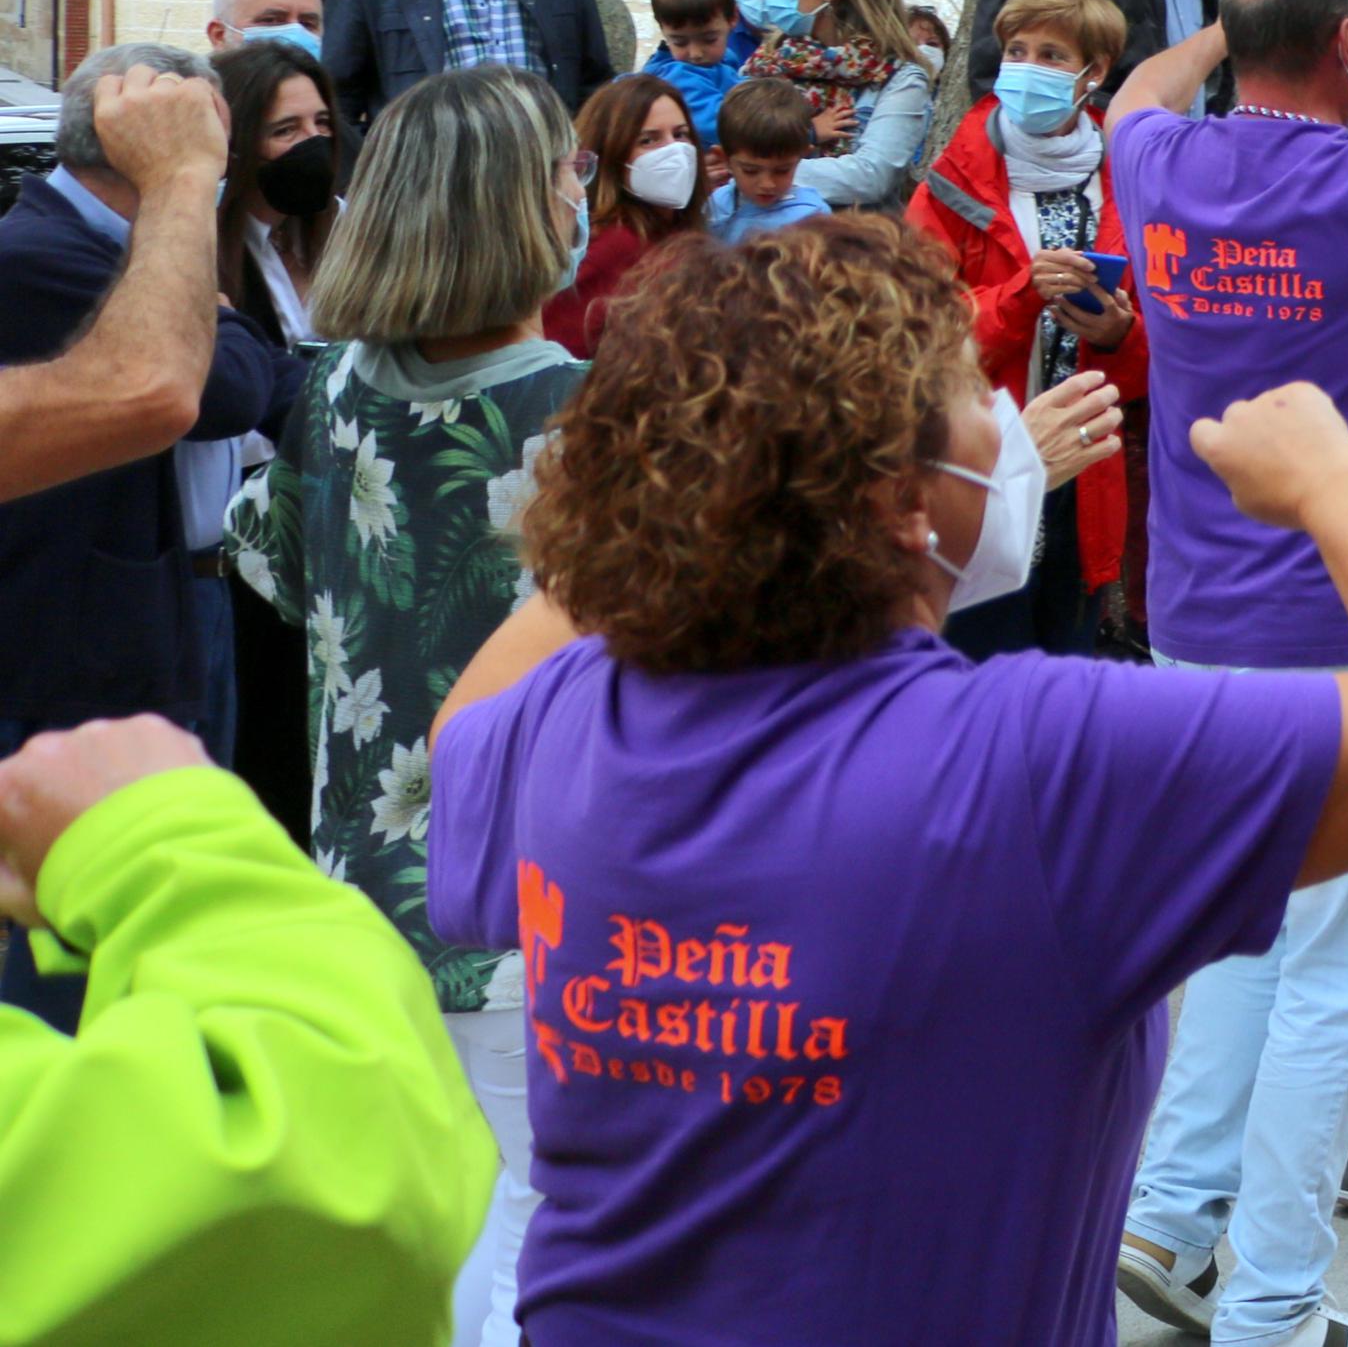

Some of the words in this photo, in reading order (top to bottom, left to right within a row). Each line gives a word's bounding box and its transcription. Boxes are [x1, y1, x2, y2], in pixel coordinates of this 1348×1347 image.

[1211, 238, 1297, 269] Peña
[1190, 266, 1325, 300] Castilla
[1192, 297, 1255, 318] Desde
[1266, 304, 1323, 322] 1978
[606, 914, 794, 990] Peña
[562, 975, 849, 1061] Castilla
[567, 1041, 697, 1093] Desde
[720, 1072, 844, 1107] 1978
